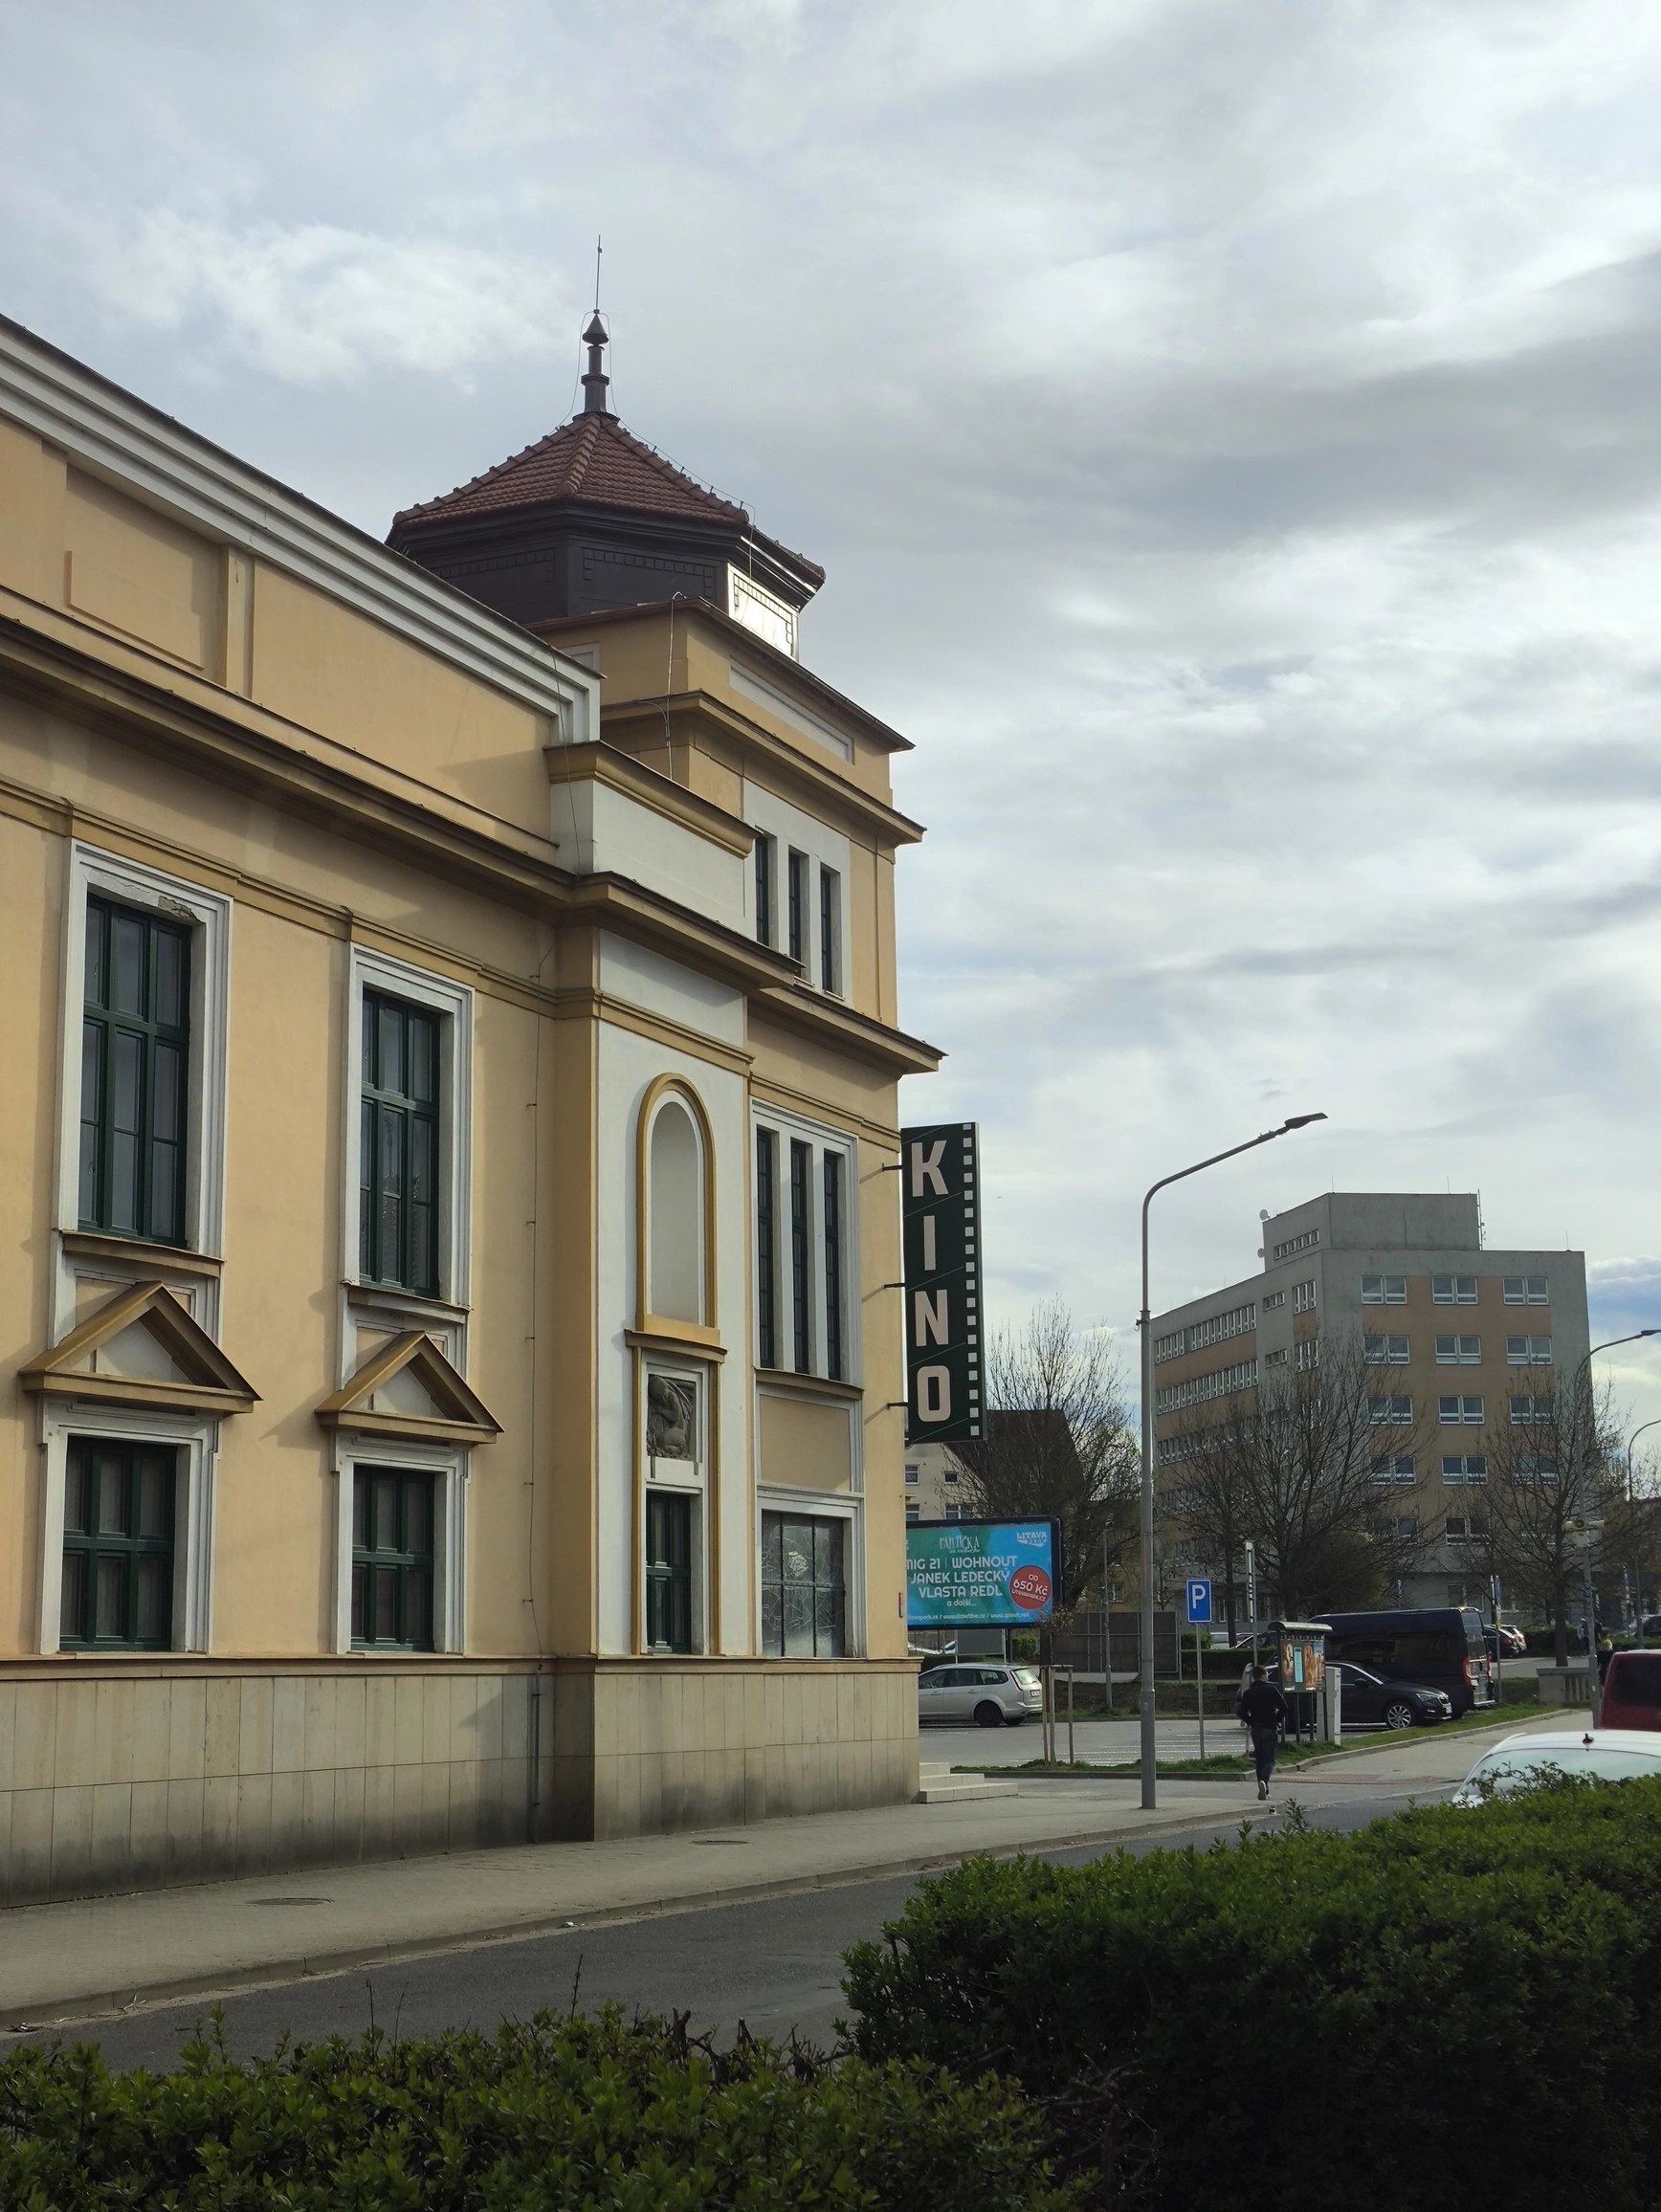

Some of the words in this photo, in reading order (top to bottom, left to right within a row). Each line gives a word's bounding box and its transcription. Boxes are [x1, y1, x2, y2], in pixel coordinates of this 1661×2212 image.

[911, 1139, 951, 1423] KINO
[1016, 1531, 1048, 1539] LITAVA
[929, 1558, 941, 1570] 21
[951, 1555, 1018, 1569] WOHNOUT
[910, 1572, 951, 1584] JANEK
[954, 1567, 1010, 1583] LEDECKÝ
[1028, 1573, 1039, 1582] OD
[918, 1585, 966, 1599] VLASTA
[969, 1584, 1004, 1597] REDL
[1012, 1579, 1033, 1592] 650
[1035, 1584, 1049, 1596] Kč
[1192, 1584, 1207, 1609] P
